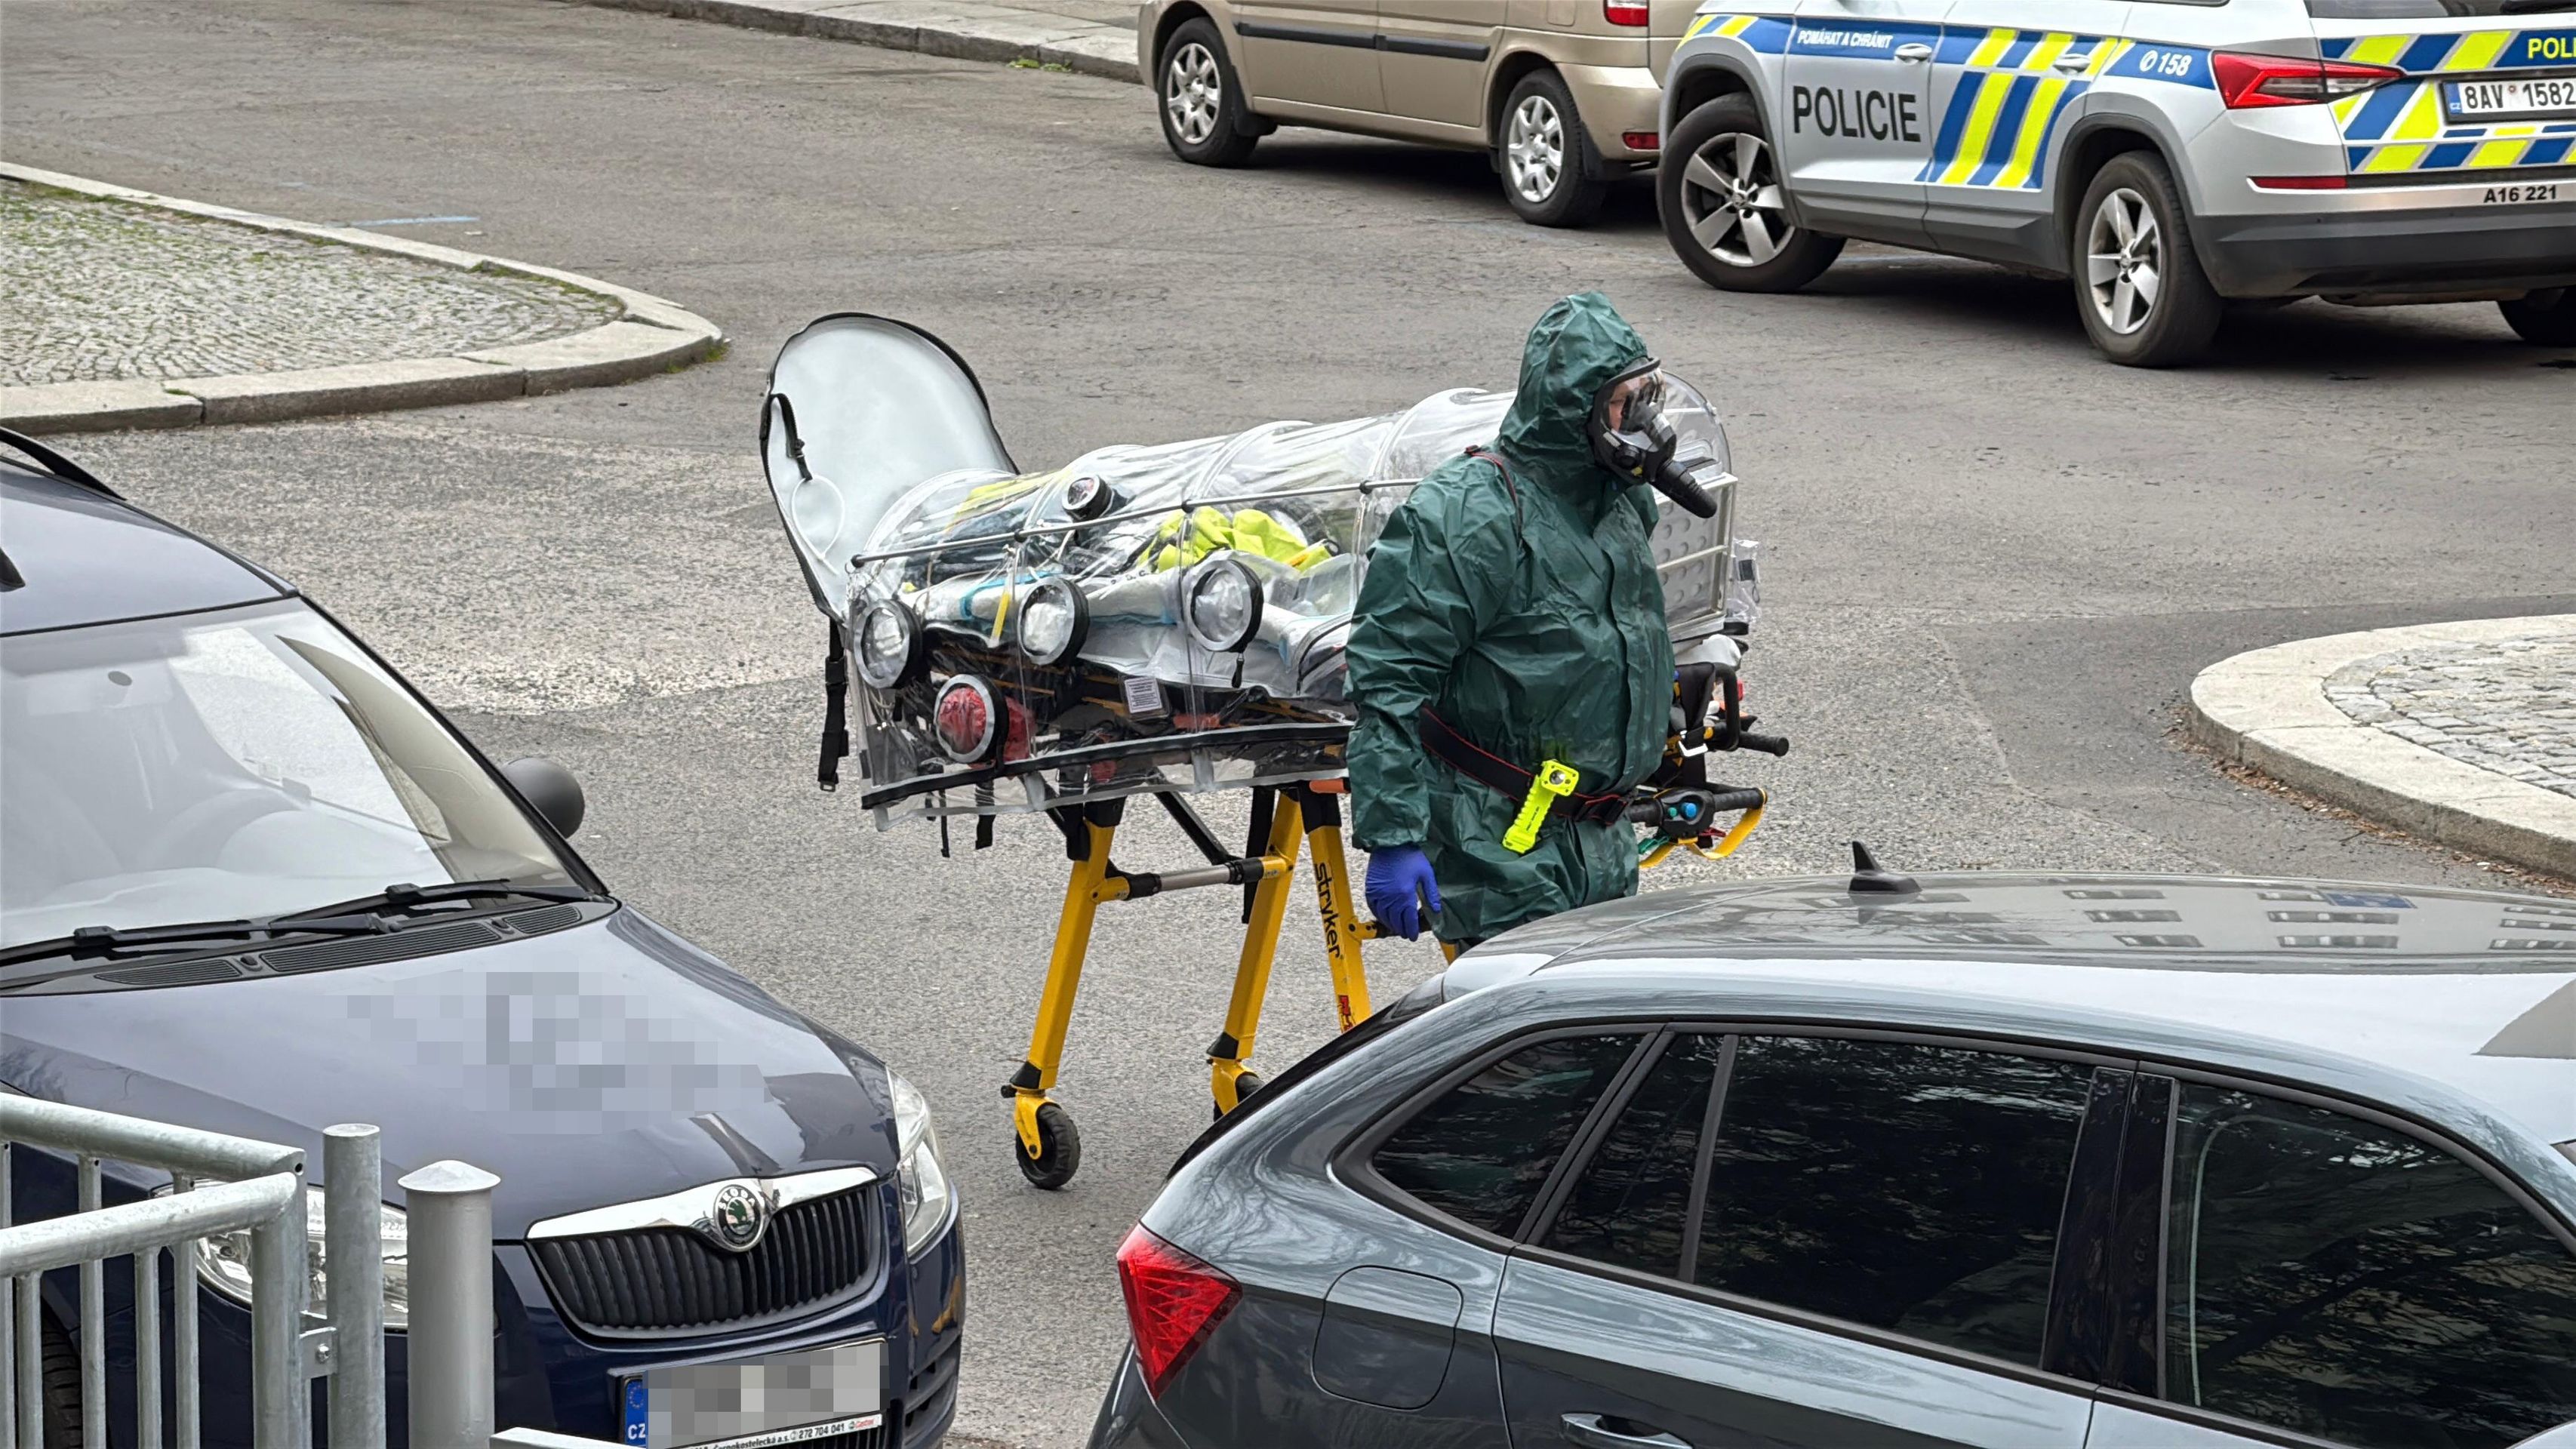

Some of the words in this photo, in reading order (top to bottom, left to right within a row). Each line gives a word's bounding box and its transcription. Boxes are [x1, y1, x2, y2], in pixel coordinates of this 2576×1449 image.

[1797, 28, 1843, 45] POMÁHAT
[1841, 32, 1850, 45] A
[1850, 31, 1893, 48] CHRÁNIT
[2158, 52, 2192, 76] 158
[2465, 85, 2504, 109] 8AV
[2522, 82, 2576, 107] 1582
[1793, 86, 1921, 142] POLICIE
[2483, 187, 2519, 203] A16
[2525, 185, 2556, 201] 221
[1313, 862, 1341, 960] stryker
[628, 1423, 646, 1440] CZ
[799, 1429, 813, 1438] 272
[814, 1426, 829, 1435] 704
[831, 1423, 845, 1433] 041
